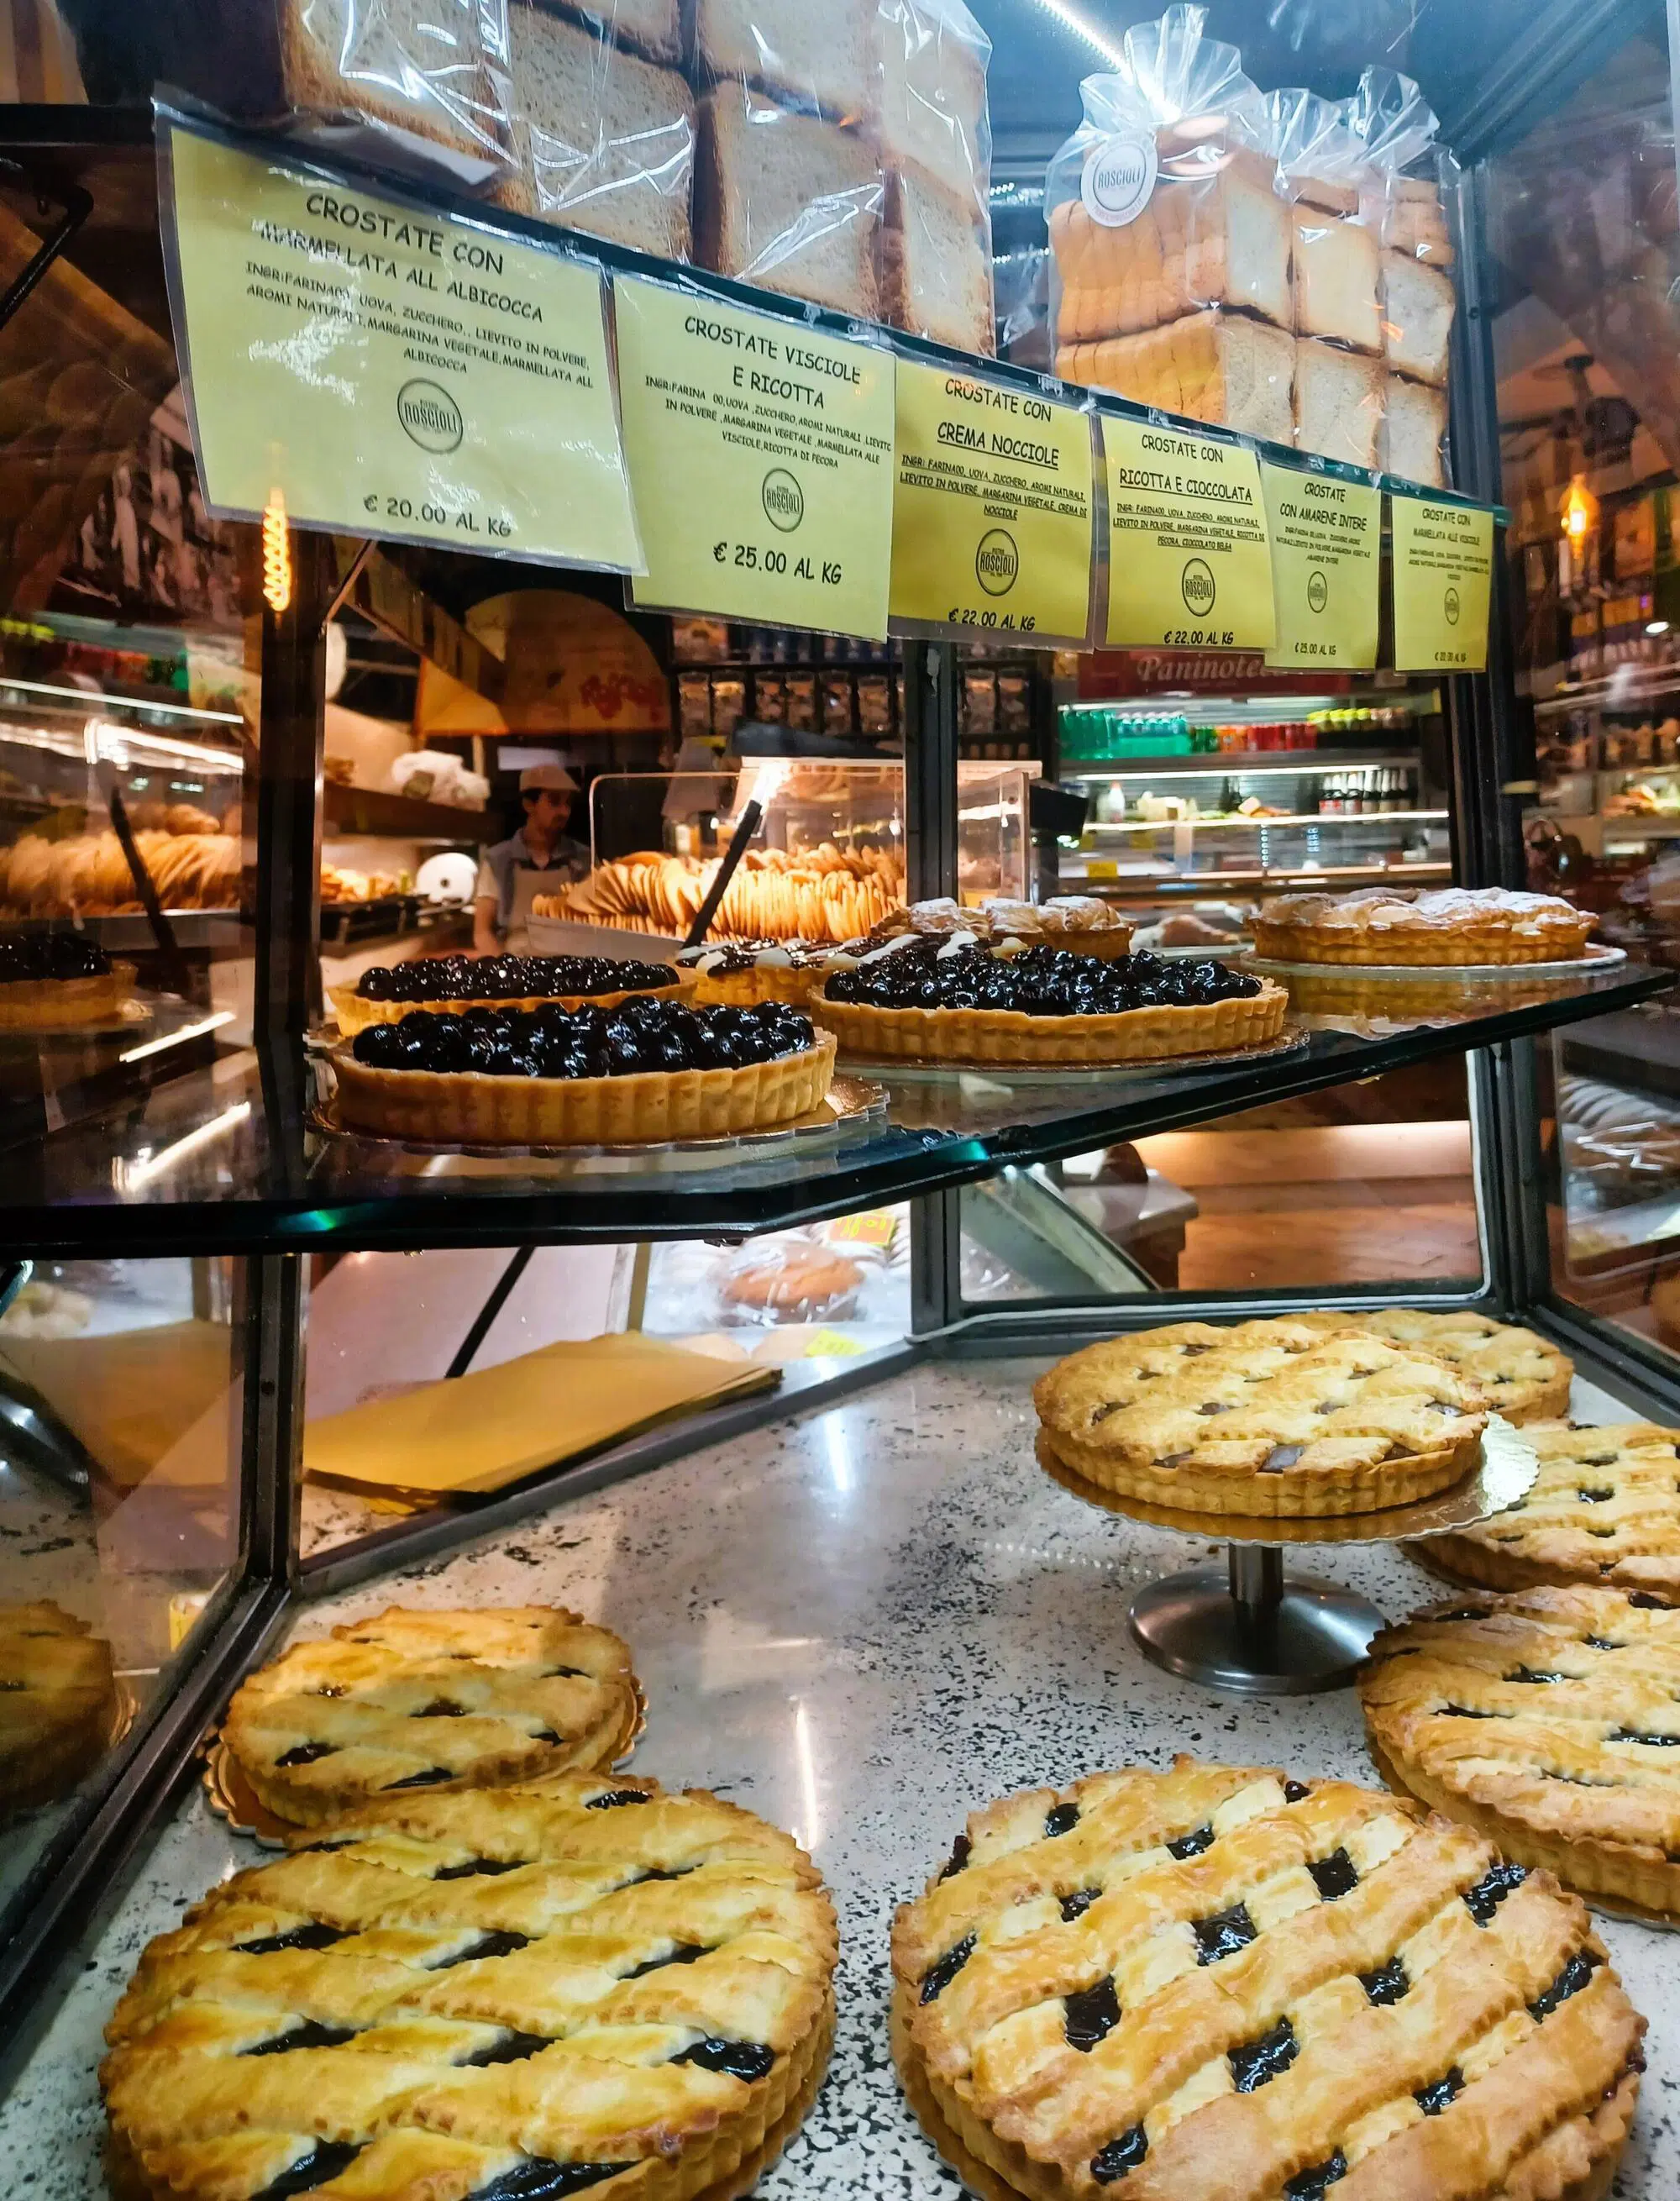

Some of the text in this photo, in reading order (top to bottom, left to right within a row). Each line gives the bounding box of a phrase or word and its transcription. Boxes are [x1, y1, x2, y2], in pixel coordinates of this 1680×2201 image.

[1098, 167, 1141, 189] ROSCIOLI
[307, 192, 503, 276] CROSTATE CON
[261, 222, 543, 323] MARMELLATA ALL ALBICOCCA
[246, 283, 292, 307] AROMI
[576, 374, 593, 389] ALL
[475, 326, 522, 350] LIEVITO
[526, 340, 539, 355] IN
[685, 316, 861, 385] CROSTATE VISCIOLE
[403, 347, 467, 373] ALBICOCCA
[732, 364, 824, 409] E RICOTTA
[945, 378, 1051, 422] CROSTATE CON
[404, 402, 458, 433] ROSCIOLI
[665, 398, 677, 411] IN
[680, 402, 717, 422] POLVERE
[774, 426, 812, 445] VEGETALE
[864, 451, 880, 465] ALLE
[825, 424, 861, 443] NATURALI
[937, 422, 1059, 466] CREMA NOCCIOLE
[801, 450, 810, 461] DI
[1142, 434, 1223, 463] CROSTATE CON
[900, 470, 934, 486] LIEVITO
[936, 478, 947, 488] IN
[982, 486, 1022, 504] MARGARINA
[1031, 481, 1052, 494] AROMI
[1120, 468, 1252, 502] RICOTTA E CIOCCOLATA
[1305, 482, 1346, 502] CROSTATE
[766, 487, 800, 515] ROSCIOLI
[984, 503, 1018, 519] NOCCIOLE
[363, 494, 512, 538] € 20.00 AL KG
[1280, 503, 1367, 532] CON AMARENE INTERE
[1422, 508, 1471, 526] CROSTATE CON
[713, 542, 843, 585] € 25.00 AL KG
[980, 553, 1015, 574] ROSCIOLI
[1185, 580, 1212, 597] ROSCIOLI
[948, 607, 1036, 631] € 22.00 AL KG
[1164, 630, 1234, 645] € 22.00 AL KG
[1319, 644, 1327, 655] AL
[1329, 644, 1336, 655] KG
